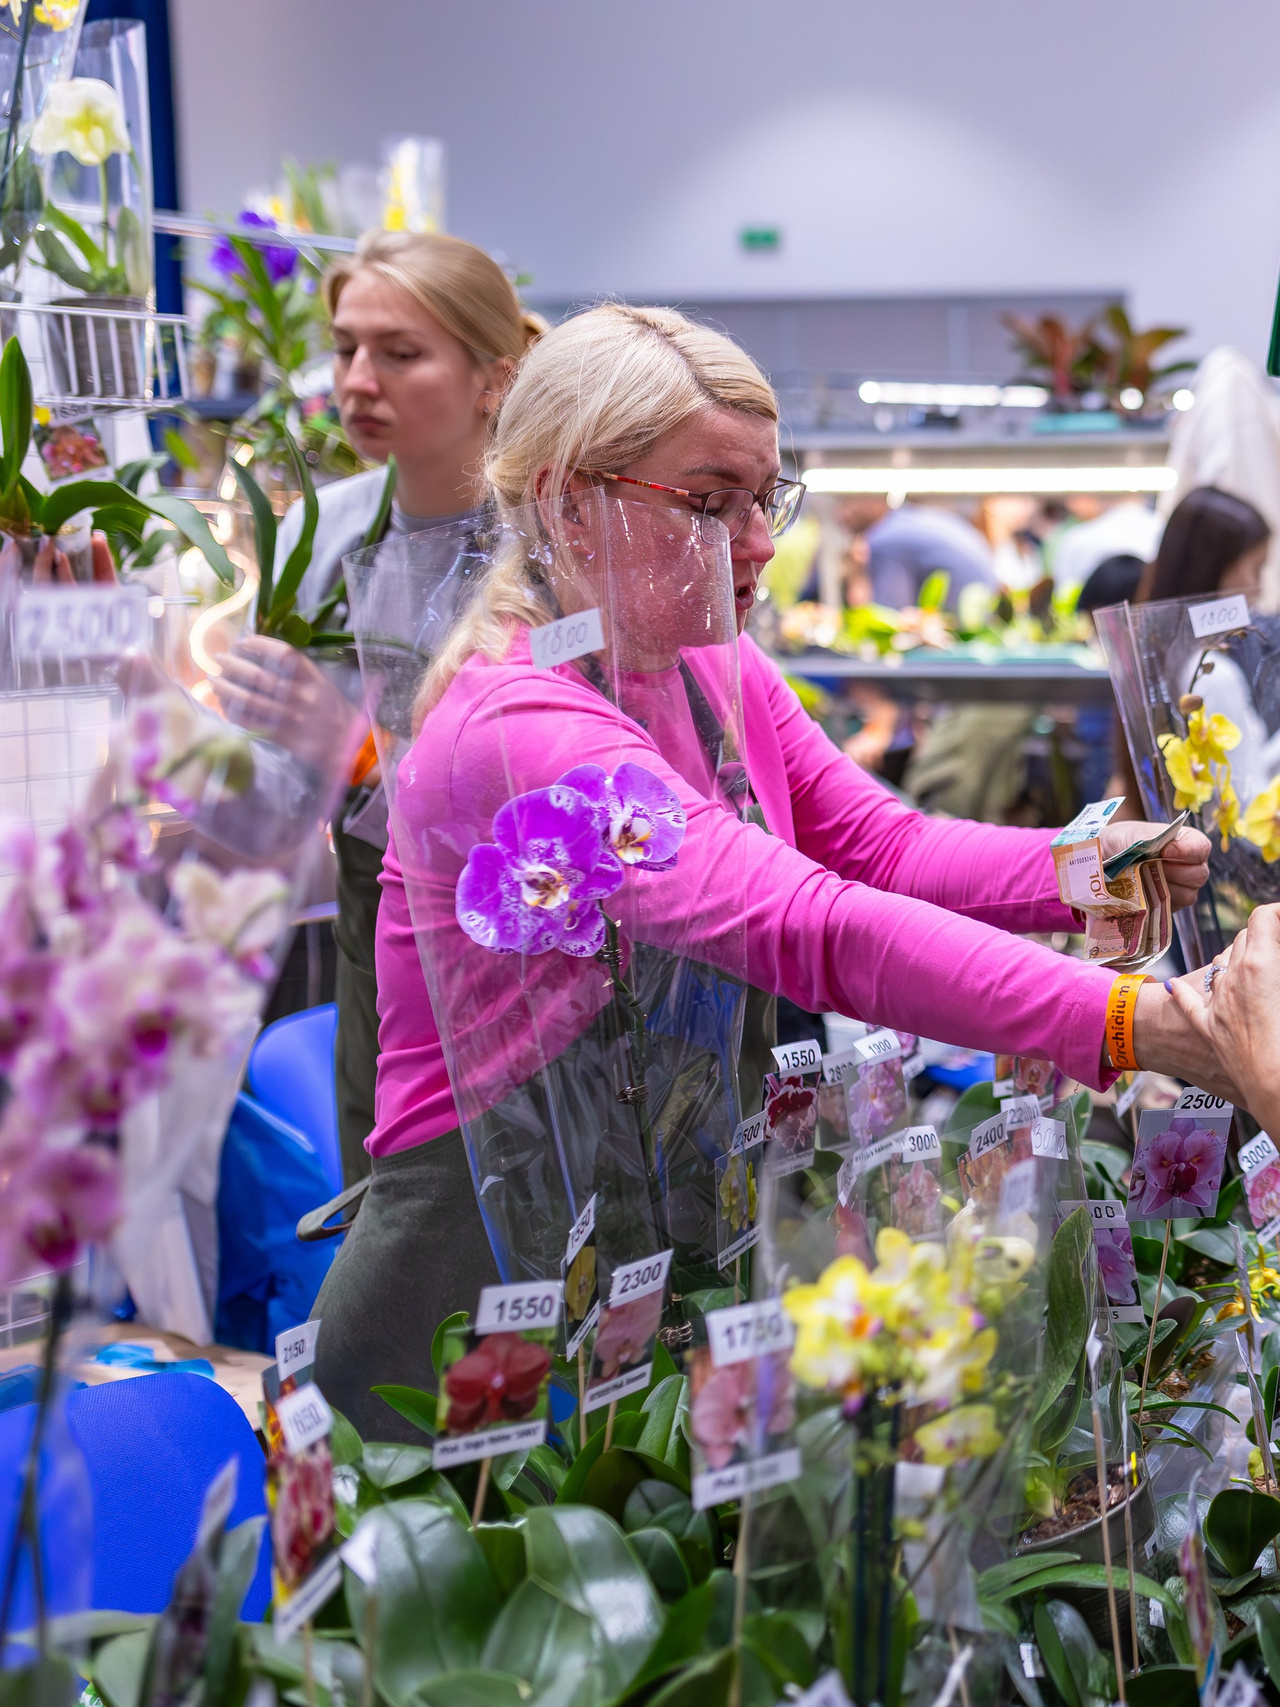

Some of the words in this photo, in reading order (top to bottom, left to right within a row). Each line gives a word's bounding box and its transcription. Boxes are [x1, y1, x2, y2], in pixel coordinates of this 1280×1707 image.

[1111, 985, 1131, 1066] Orchidium
[782, 1048, 816, 1070] 1550
[868, 1039, 892, 1056] 1900
[1181, 1092, 1226, 1110] 2500
[909, 1133, 939, 1153] 3000
[976, 1122, 1005, 1154] 2400
[1242, 1140, 1272, 1170] 3000
[619, 1261, 662, 1294] 2300
[494, 1295, 555, 1323] 1550
[283, 1338, 305, 1364] 2150
